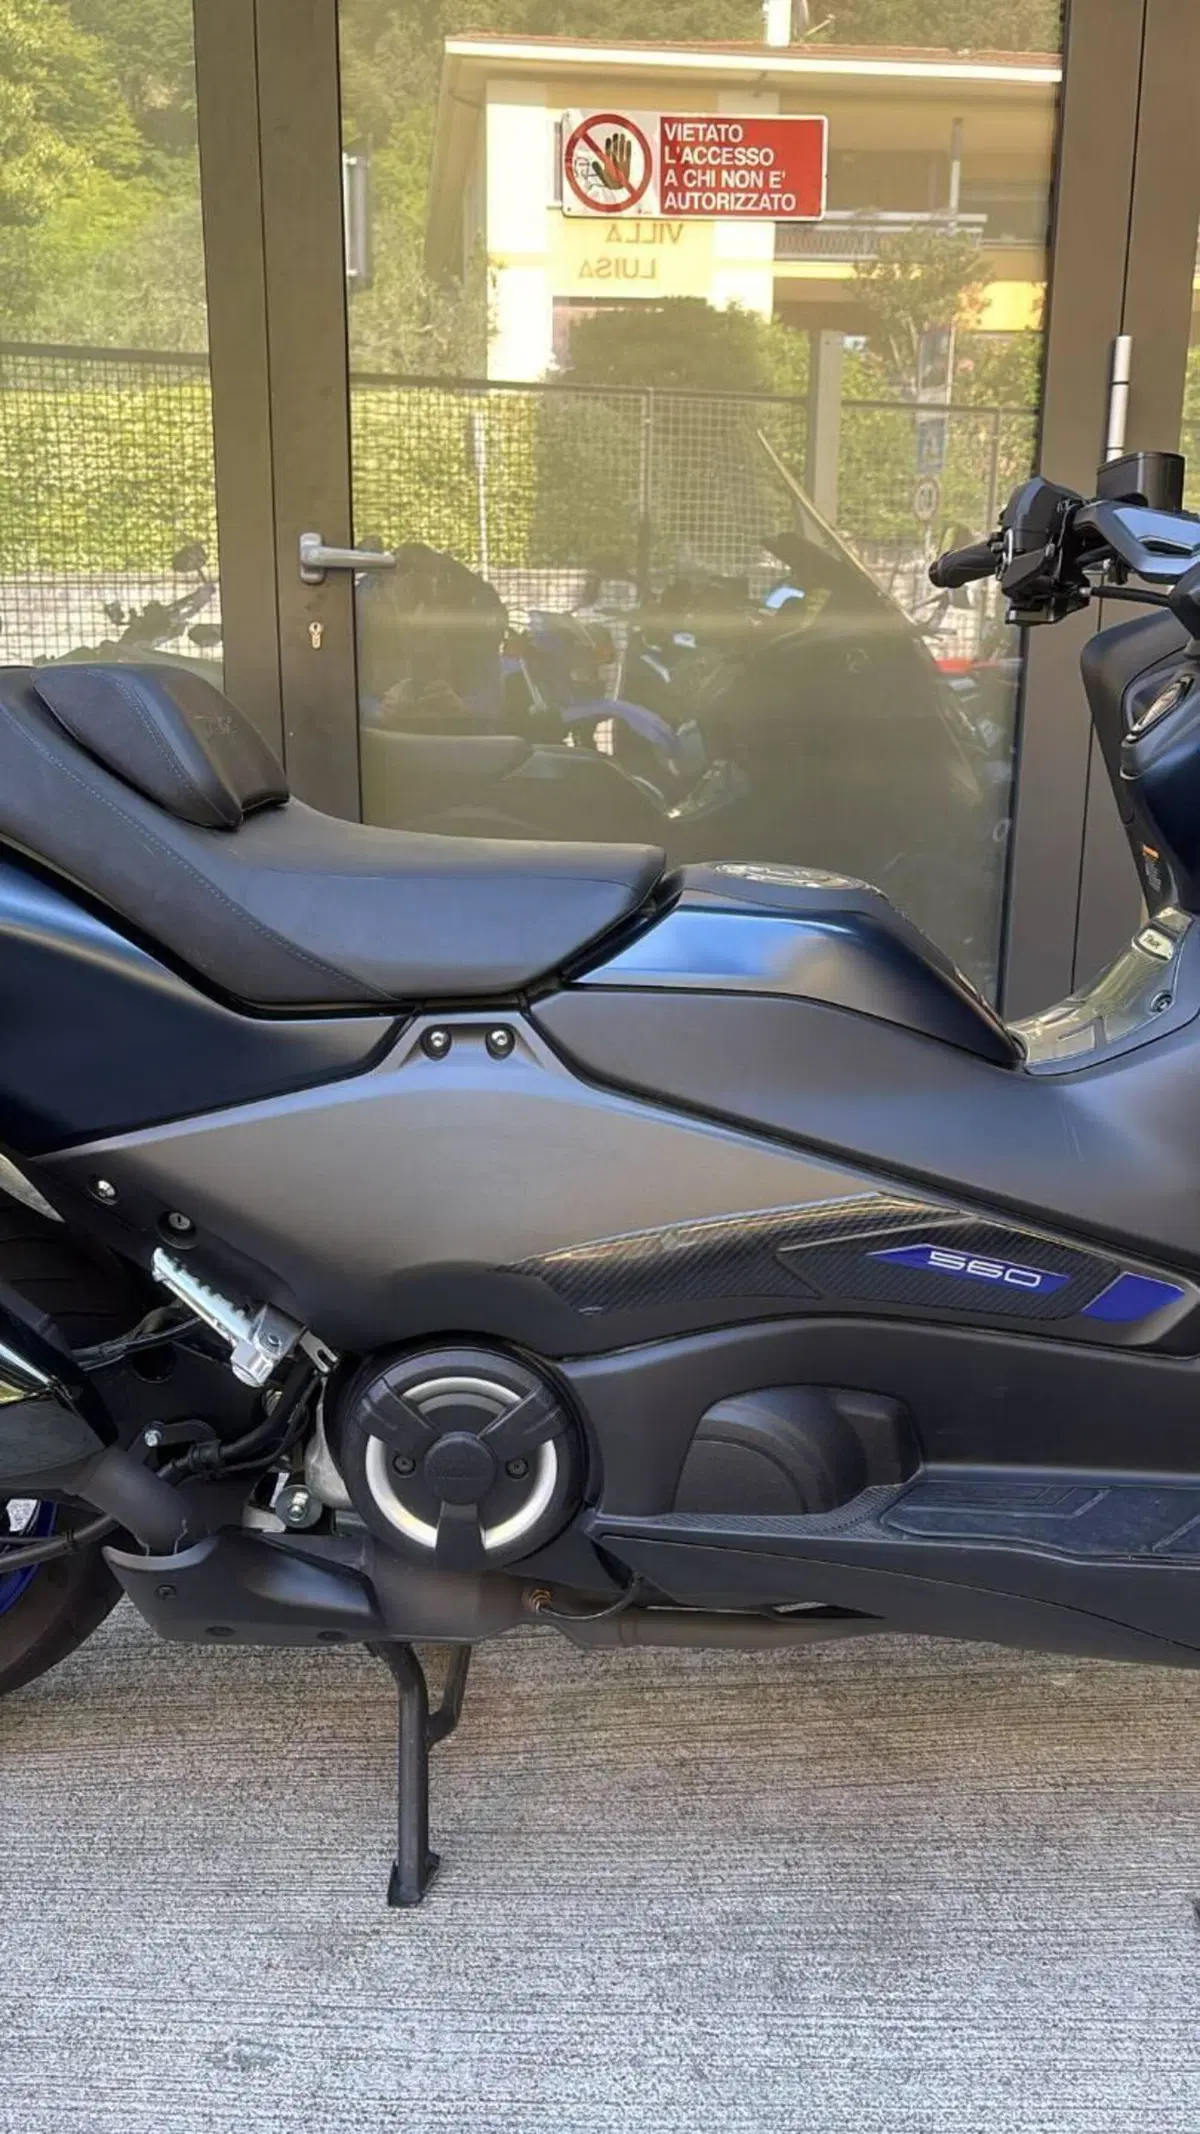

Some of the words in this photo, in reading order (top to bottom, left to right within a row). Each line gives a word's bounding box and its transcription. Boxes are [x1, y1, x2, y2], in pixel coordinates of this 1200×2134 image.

[664, 123, 743, 142] VIETATO
[664, 147, 774, 166] L'ACCESSO
[664, 170, 678, 187] A
[683, 170, 716, 188] CHI
[721, 170, 764, 189] NON
[769, 170, 786, 189] E'
[664, 192, 796, 212] AUTORIZZATO
[928, 1250, 1041, 1288] 560
